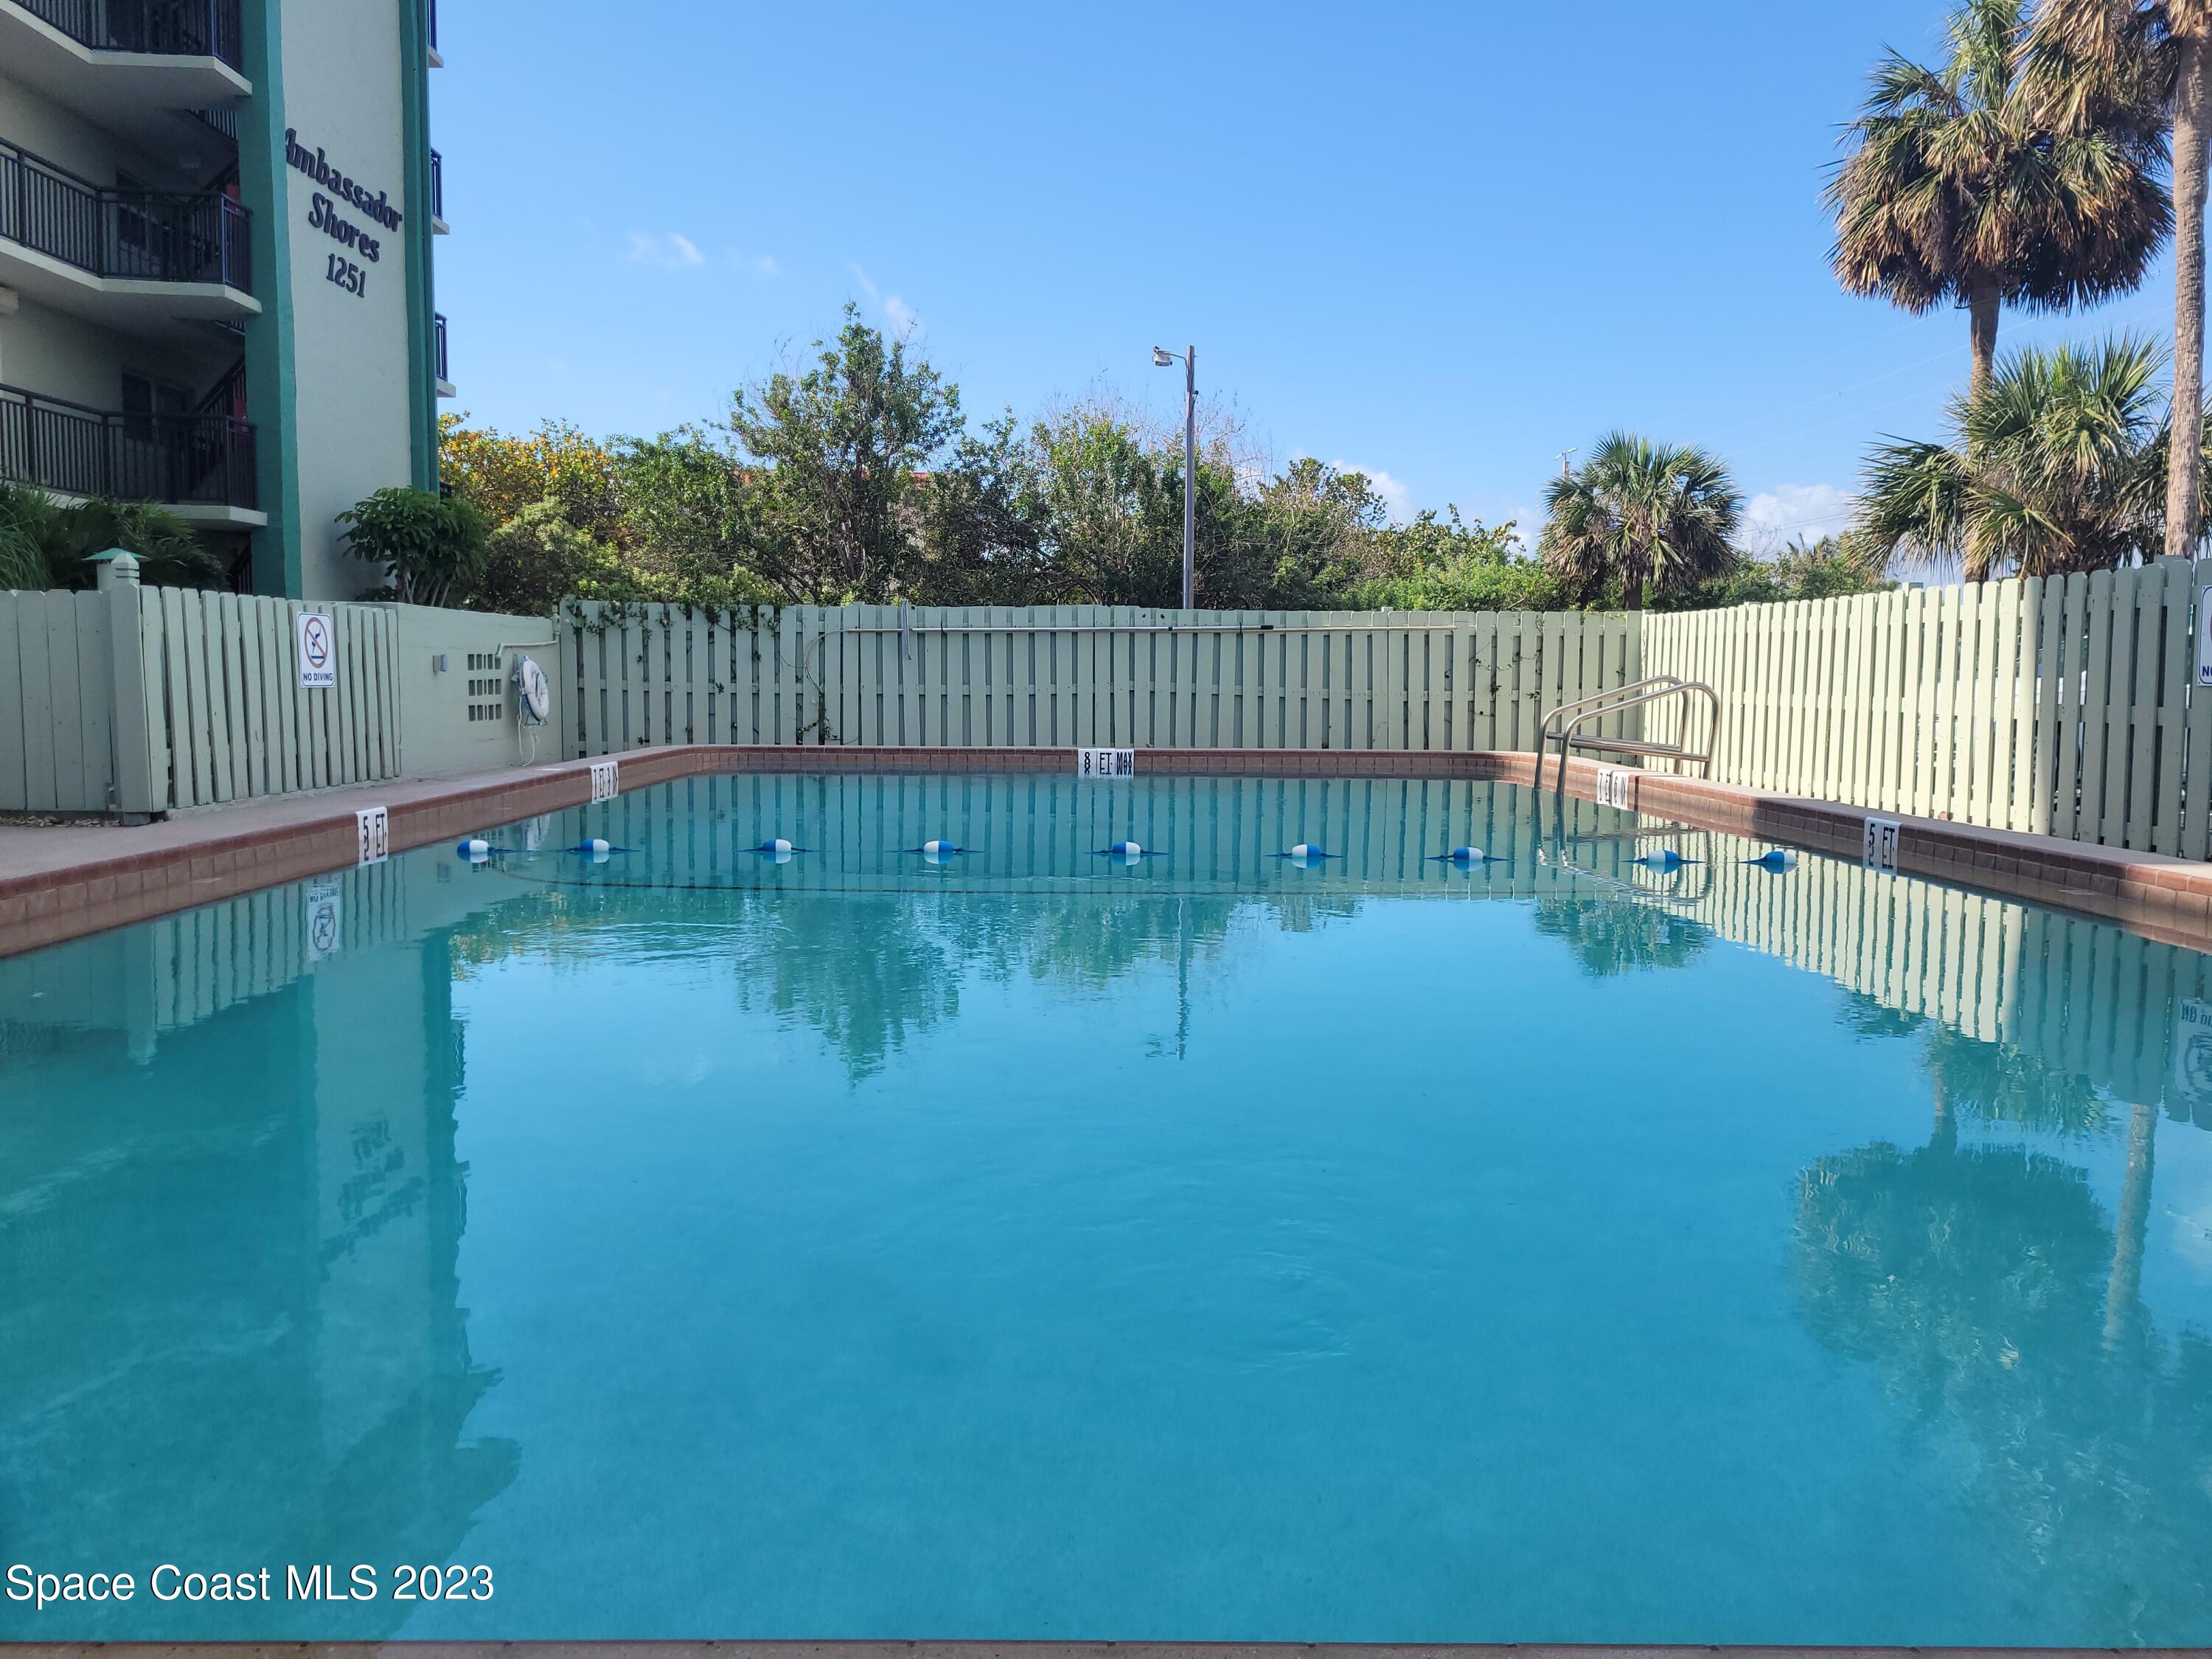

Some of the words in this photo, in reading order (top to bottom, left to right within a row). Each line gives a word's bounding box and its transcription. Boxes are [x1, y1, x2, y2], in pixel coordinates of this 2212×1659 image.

[285, 128, 403, 232] Ambassador
[308, 192, 380, 262] Shores
[326, 253, 366, 298] 1251
[303, 672, 312, 681] NO
[313, 672, 333, 681] DIVING
[2202, 666, 2212, 677] N
[1084, 752, 1091, 764] 8
